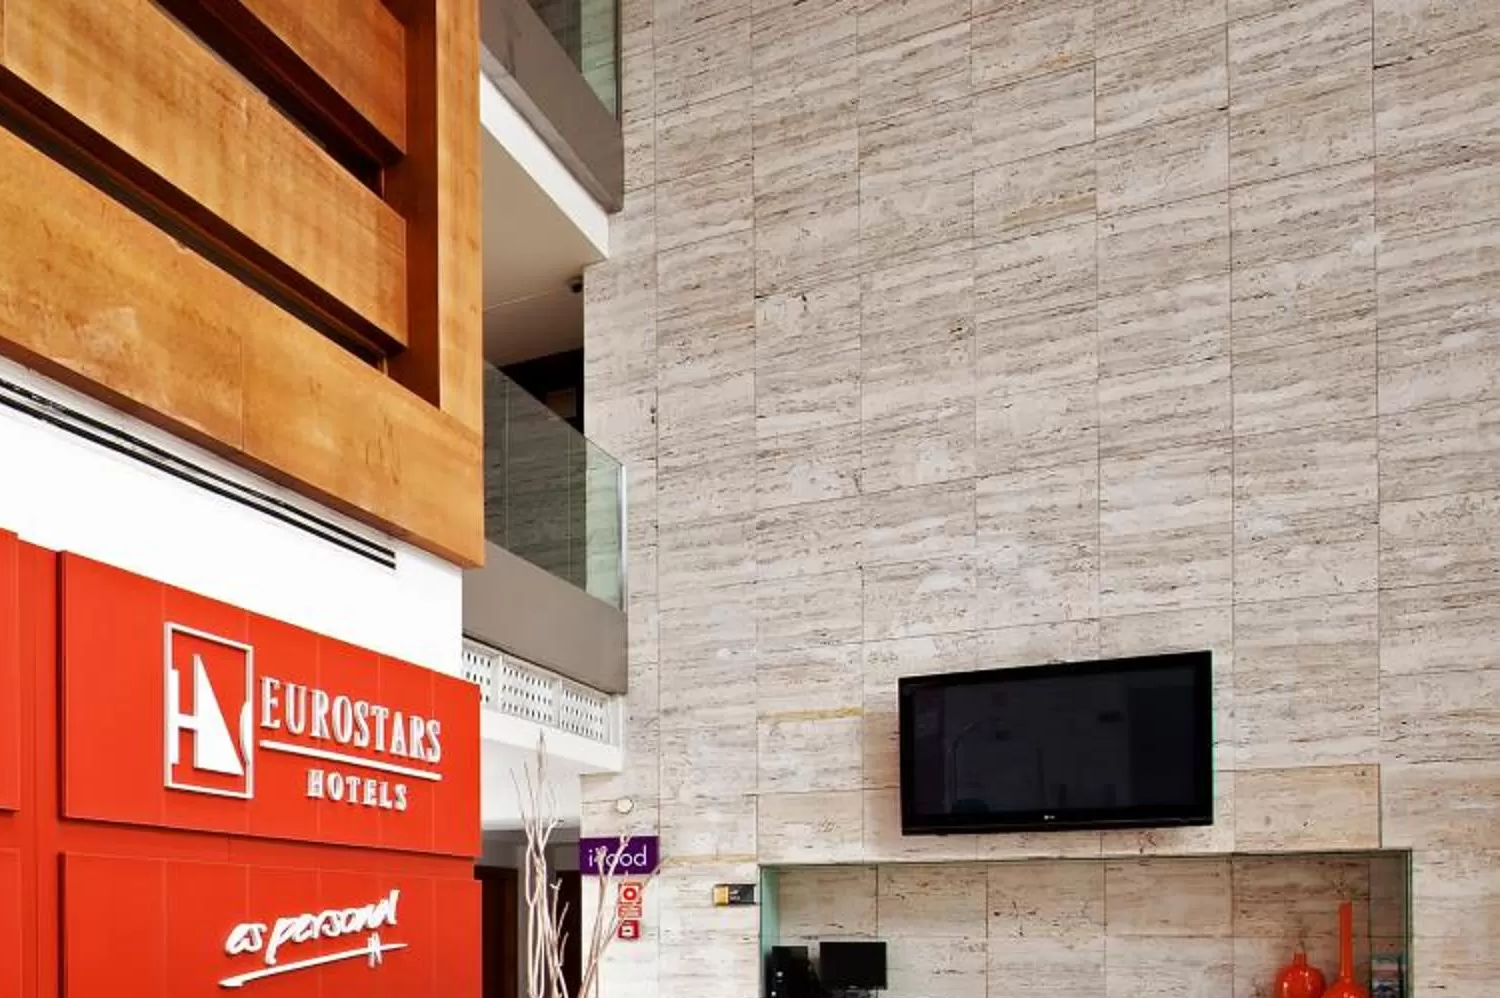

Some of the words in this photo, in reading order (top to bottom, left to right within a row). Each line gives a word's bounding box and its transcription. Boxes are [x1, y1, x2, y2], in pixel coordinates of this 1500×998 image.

[260, 676, 442, 763] EUROSTARS
[307, 769, 407, 811] HOTELS
[588, 844, 647, 867] iood
[225, 923, 267, 955] as
